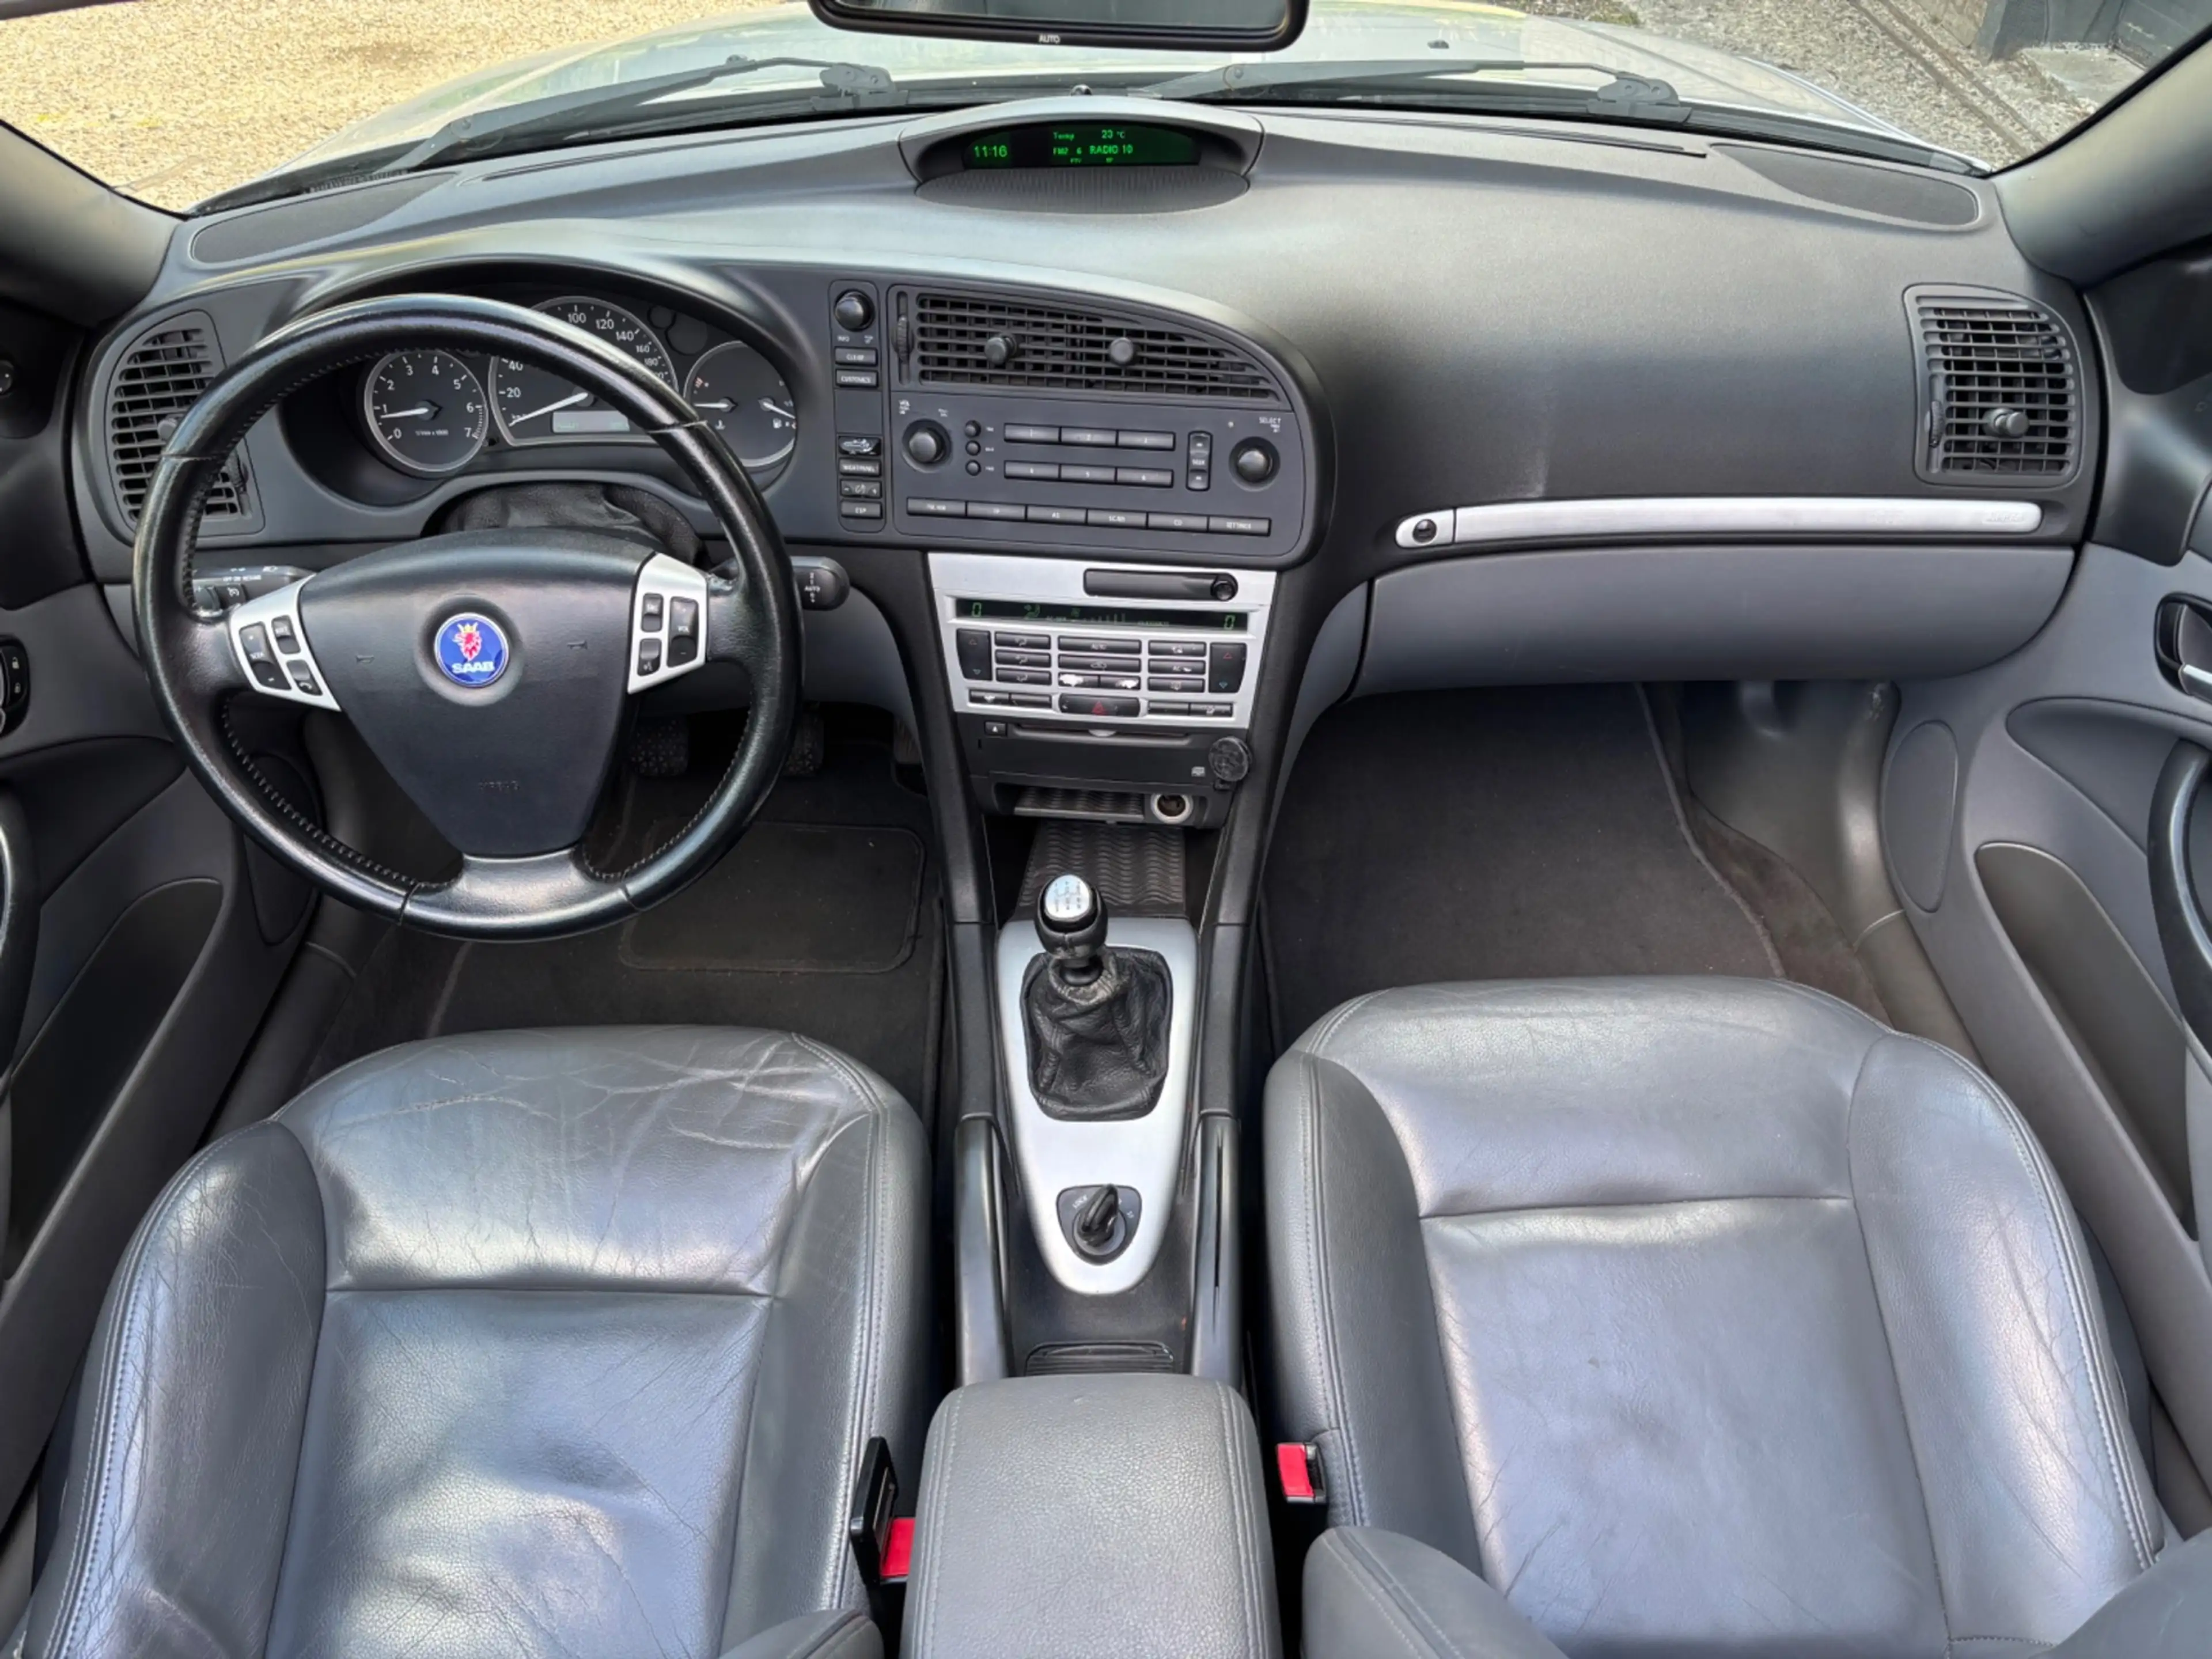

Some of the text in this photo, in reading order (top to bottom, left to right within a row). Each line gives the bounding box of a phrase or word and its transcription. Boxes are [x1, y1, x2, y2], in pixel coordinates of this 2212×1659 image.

[1053, 132, 1075, 141] Temp
[1101, 130, 1113, 139] 23
[974, 145, 1007, 157] 11:16
[1089, 145, 1118, 154] RADIO
[1122, 145, 1133, 154] 10
[568, 313, 586, 323] 100
[596, 319, 615, 329] 120
[615, 331, 634, 341] 140
[406, 365, 413, 376] 3
[432, 365, 440, 375] 4
[509, 361, 523, 371] 40
[387, 380, 395, 391] 2
[453, 379, 461, 390] 5
[506, 387, 521, 397] 20
[382, 404, 387, 413] 1
[466, 402, 474, 413] 6
[393, 428, 402, 438] 0
[464, 427, 472, 438] 7
[452, 661, 494, 674] SAAB
